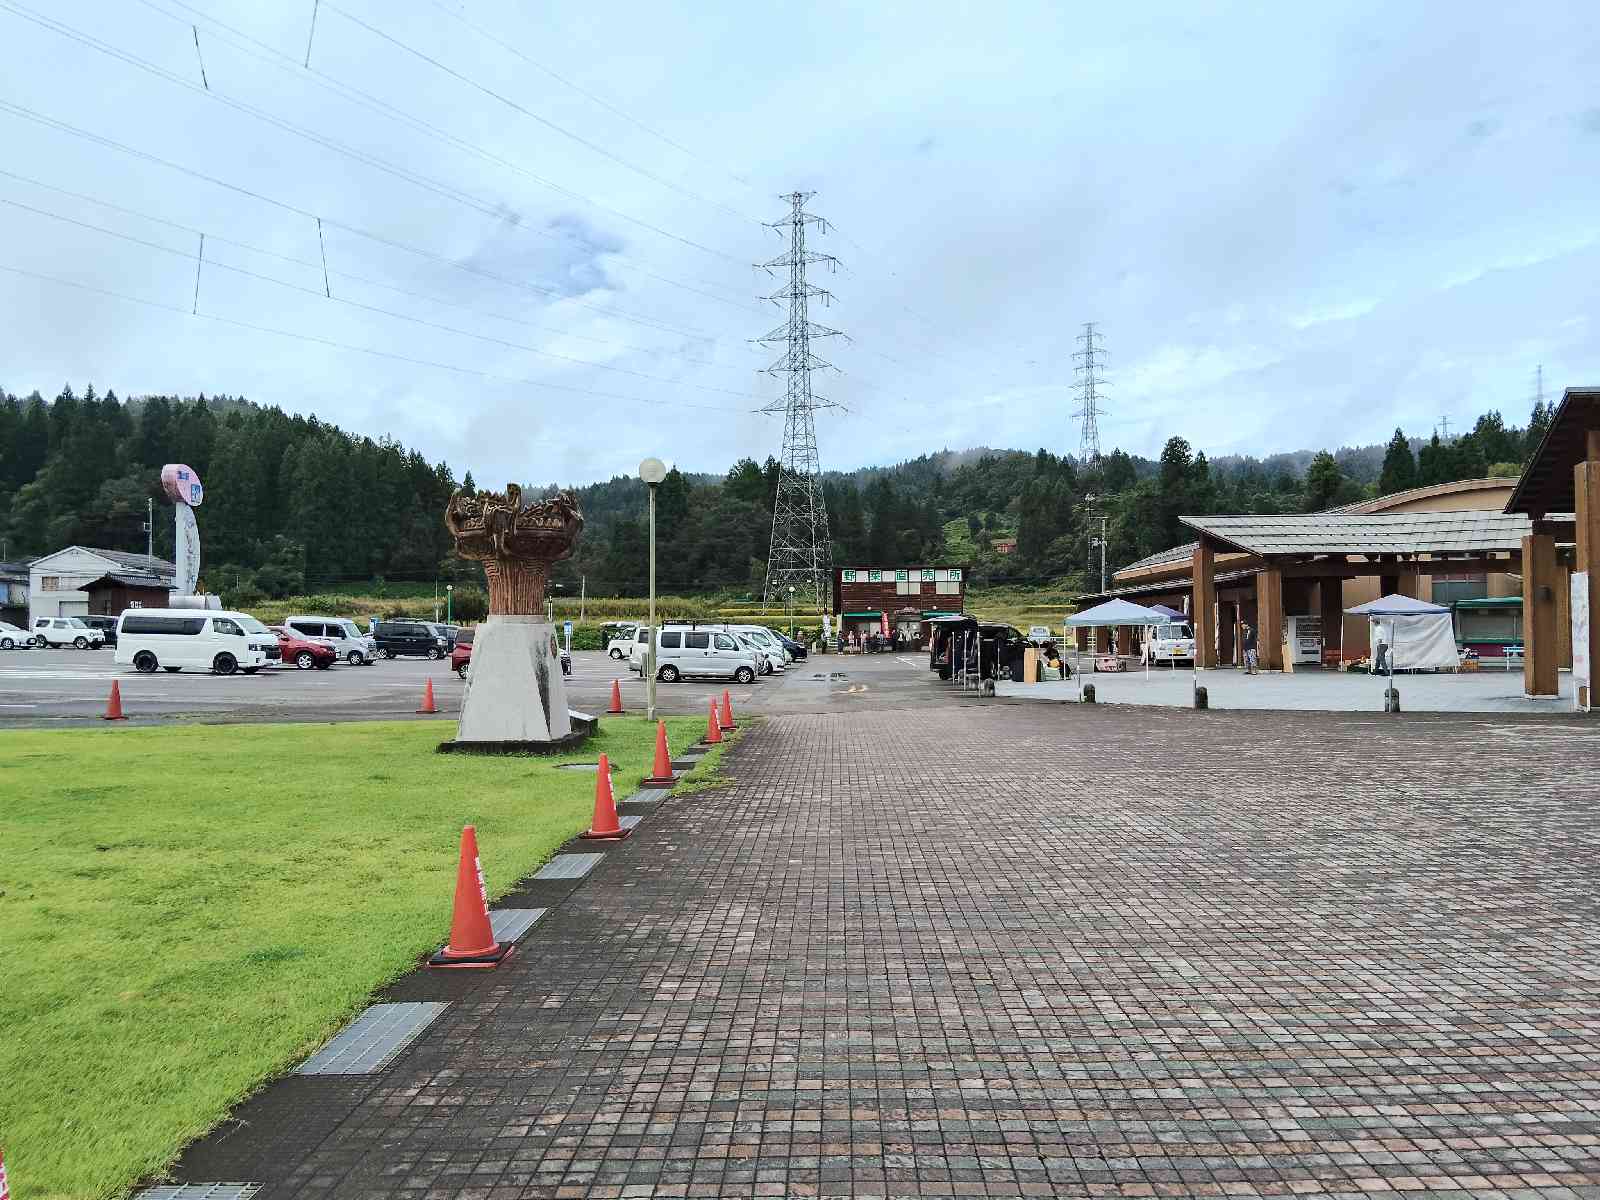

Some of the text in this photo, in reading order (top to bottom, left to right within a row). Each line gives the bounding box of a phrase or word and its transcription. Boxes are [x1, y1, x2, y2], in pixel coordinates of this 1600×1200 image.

[843, 569, 961, 581] 野菜直売所
